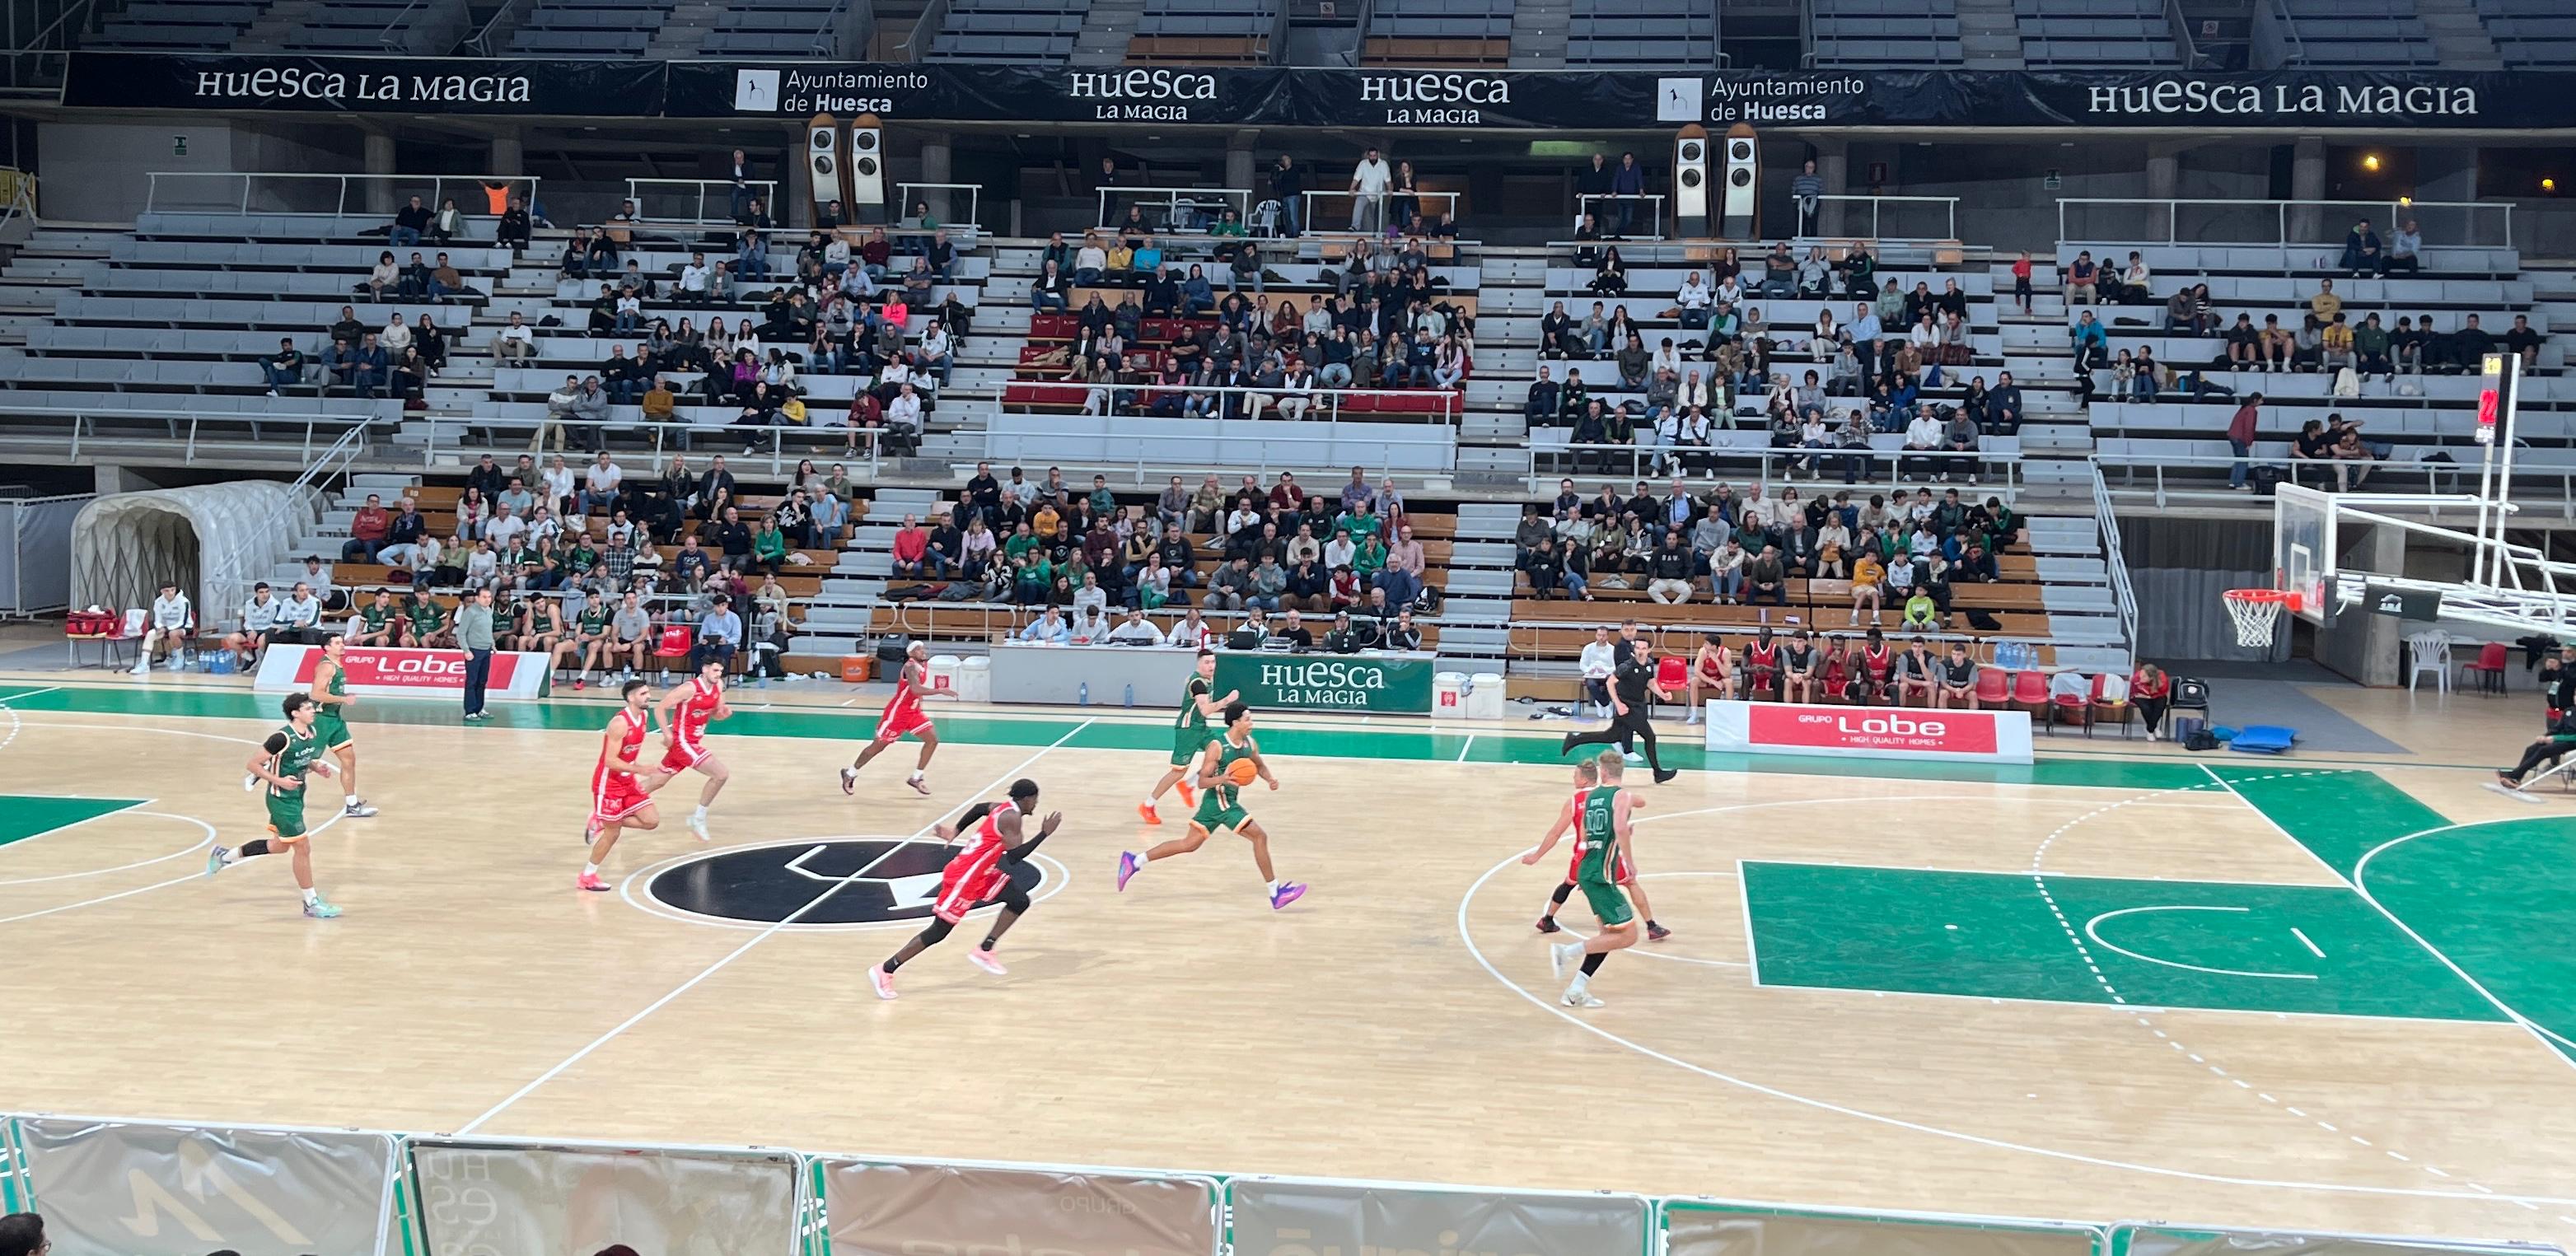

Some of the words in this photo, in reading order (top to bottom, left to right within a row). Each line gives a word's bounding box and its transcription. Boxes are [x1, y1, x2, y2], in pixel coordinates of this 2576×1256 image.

[786, 69, 928, 91] Ayuntamiento
[1711, 76, 1864, 98] Ayuntamiento
[784, 94, 809, 112] de
[815, 94, 892, 113] Huesca
[1711, 102, 1737, 121] de
[1744, 101, 1826, 120] Huesca
[345, 656, 376, 664] GRUPO
[378, 655, 466, 675] Lobe
[382, 675, 401, 683] HIGH
[402, 675, 432, 684] QUALITY
[1798, 715, 1832, 724] GRUPO
[1839, 714, 1946, 736] Lobe
[1850, 735, 1870, 744] HIGH
[1872, 736, 1905, 745] QUALITY
[1909, 738, 1937, 746] HOMES
